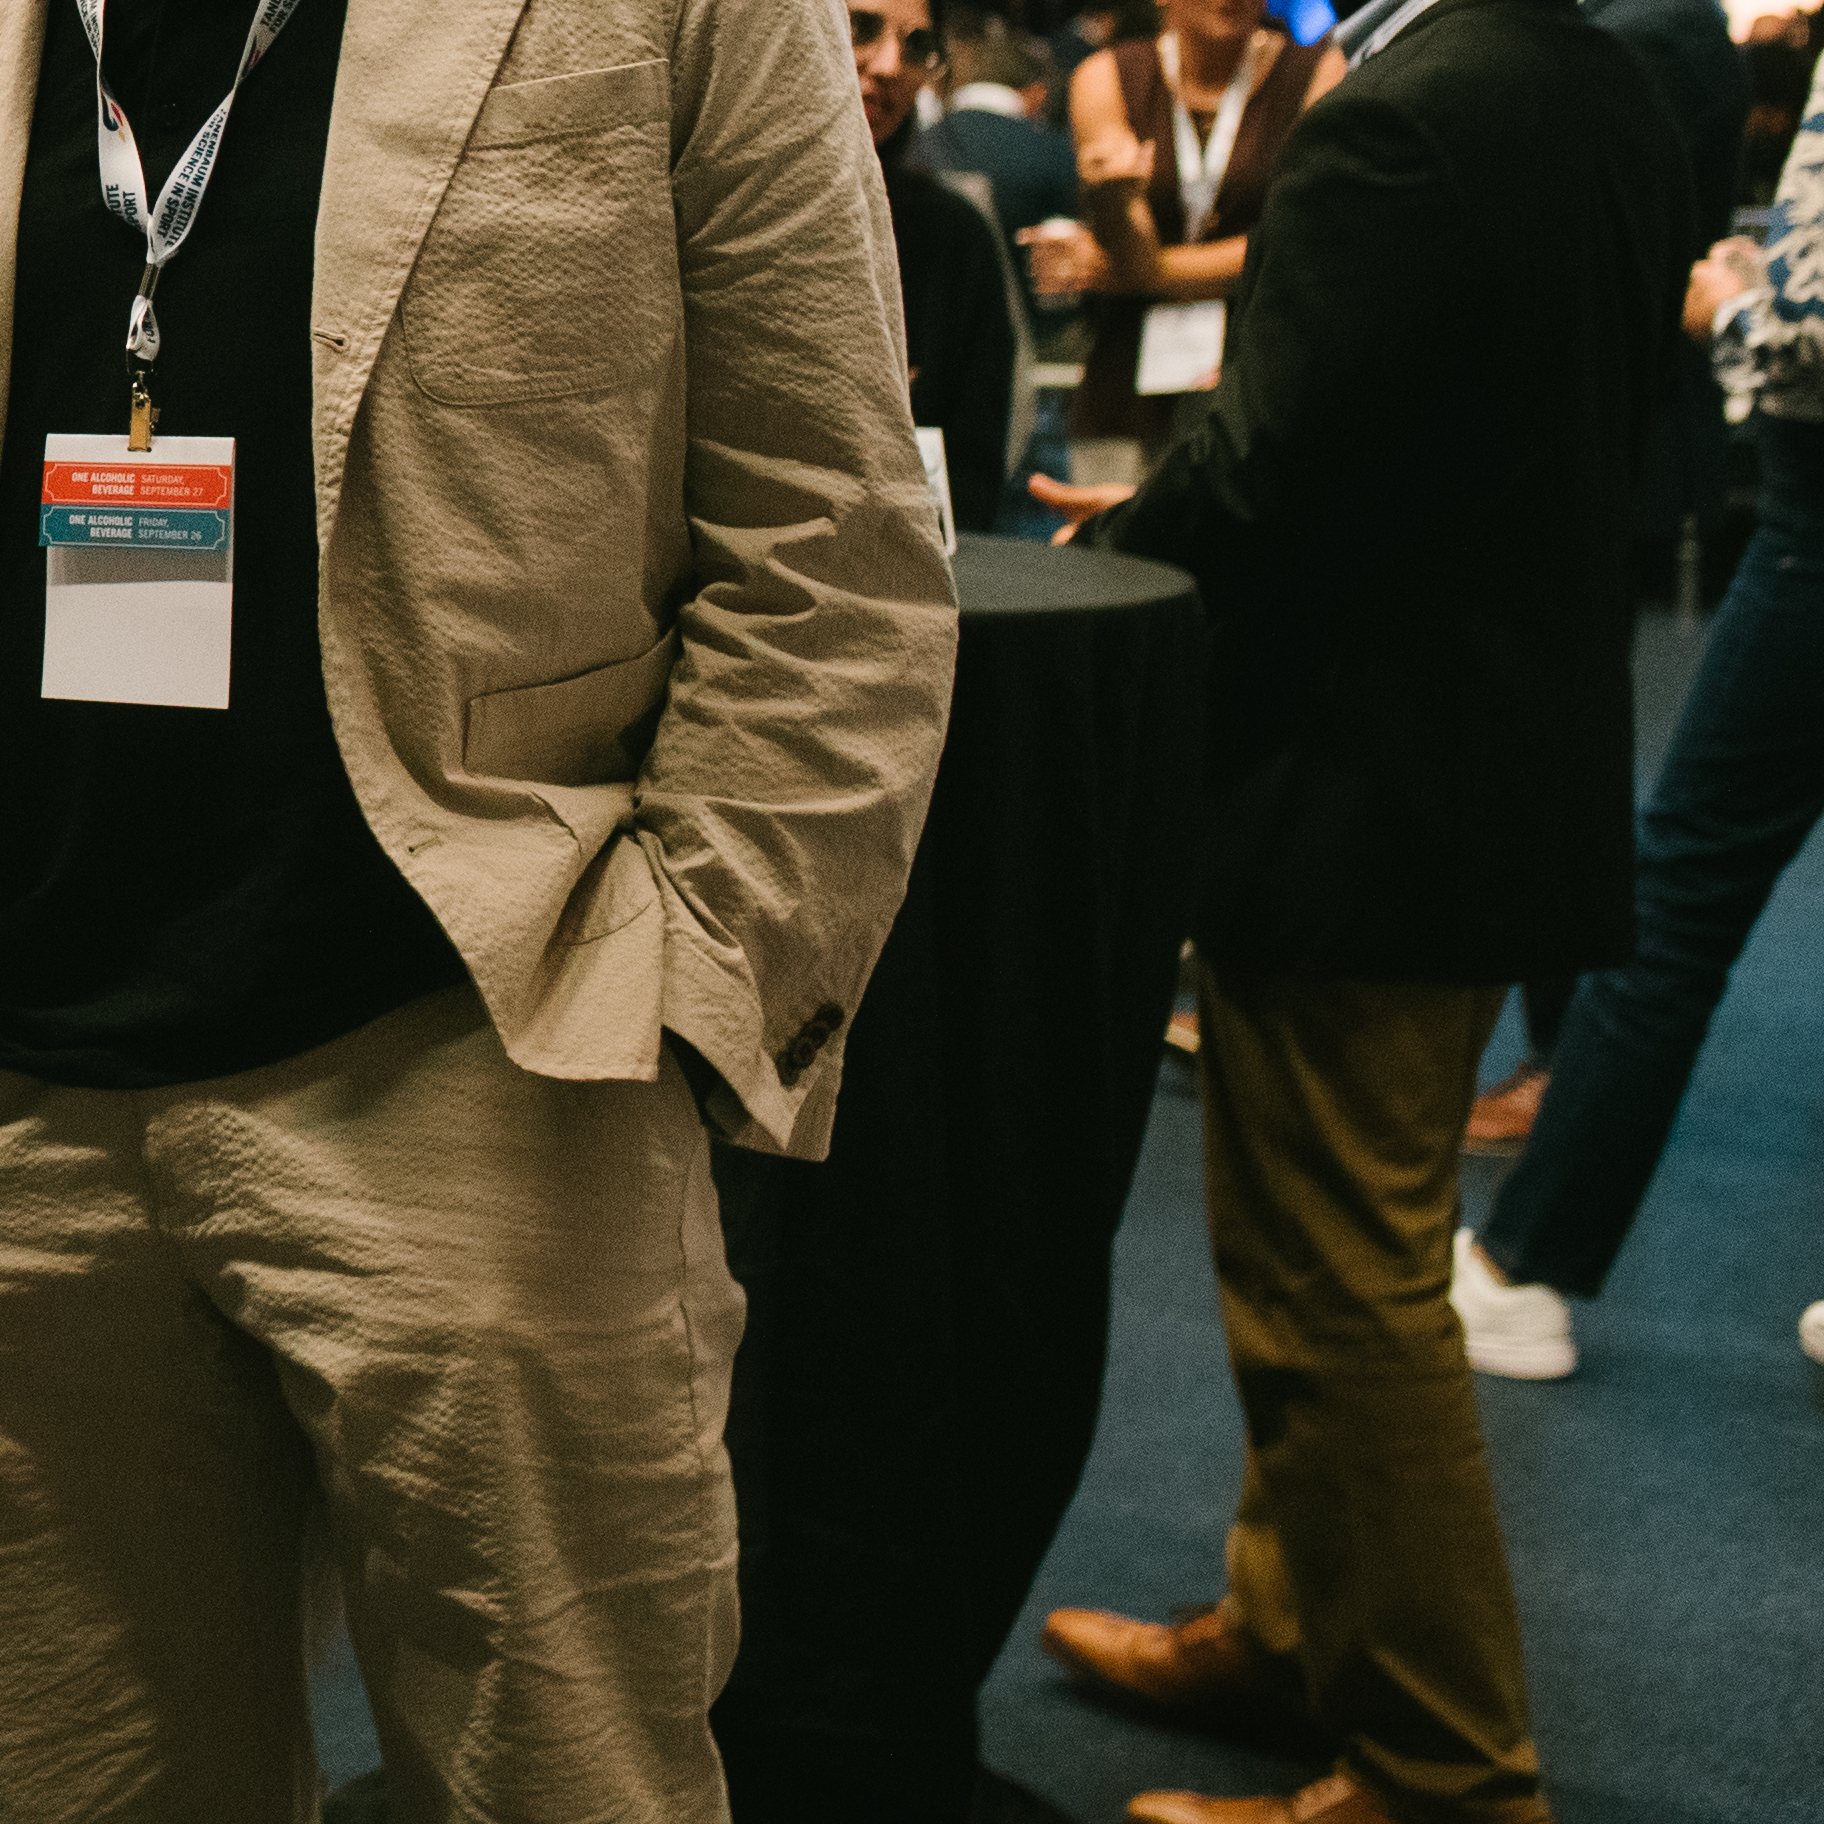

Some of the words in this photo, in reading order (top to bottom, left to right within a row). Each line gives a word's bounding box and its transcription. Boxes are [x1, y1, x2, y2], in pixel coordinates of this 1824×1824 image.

[269, 8, 288, 34] FOR
[178, 131, 211, 182] SCIENCE
[171, 181, 186, 198] IN
[157, 197, 180, 238] SPORT
[165, 188, 199, 248] INSTITUTE
[71, 472, 89, 483] ONE
[90, 472, 135, 484] ALCOHOLIC
[140, 474, 185, 486] SATURDAY,
[92, 484, 135, 496] BEVERAGE
[139, 486, 190, 497] SEPTEMBER
[192, 487, 204, 497] 27
[69, 514, 86, 525] ONE
[87, 515, 133, 527] ALCOHOLIC
[138, 517, 170, 528] FRIDAY,
[90, 527, 133, 539] BEVERAGE
[137, 528, 189, 540] SEPTEMBER
[190, 530, 202, 541] 26
